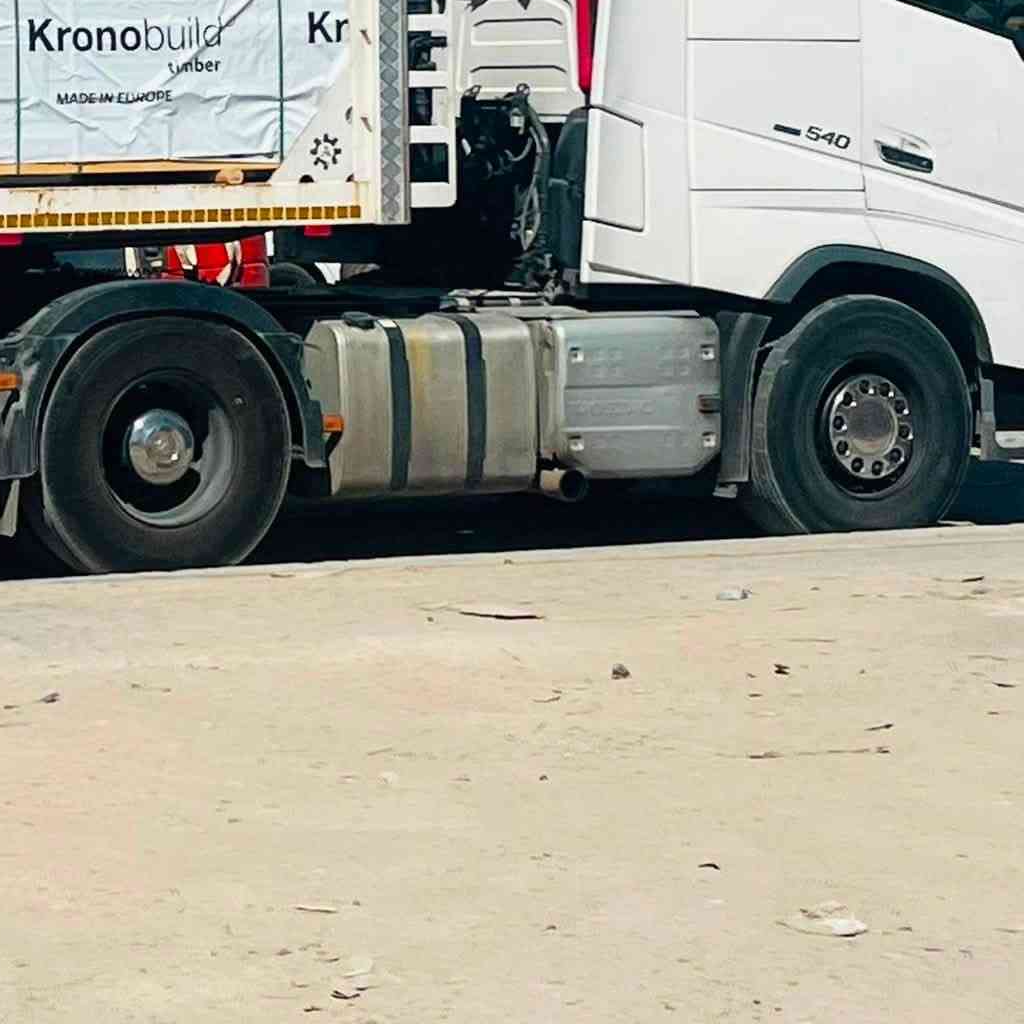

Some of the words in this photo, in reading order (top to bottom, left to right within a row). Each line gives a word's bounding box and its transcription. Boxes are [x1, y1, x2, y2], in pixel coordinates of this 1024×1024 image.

[27, 15, 223, 53] Kronobuild
[56, 91, 97, 105] MADE
[98, 91, 115, 105] IN
[117, 89, 173, 104] EUROPE
[804, 125, 851, 150] 540
